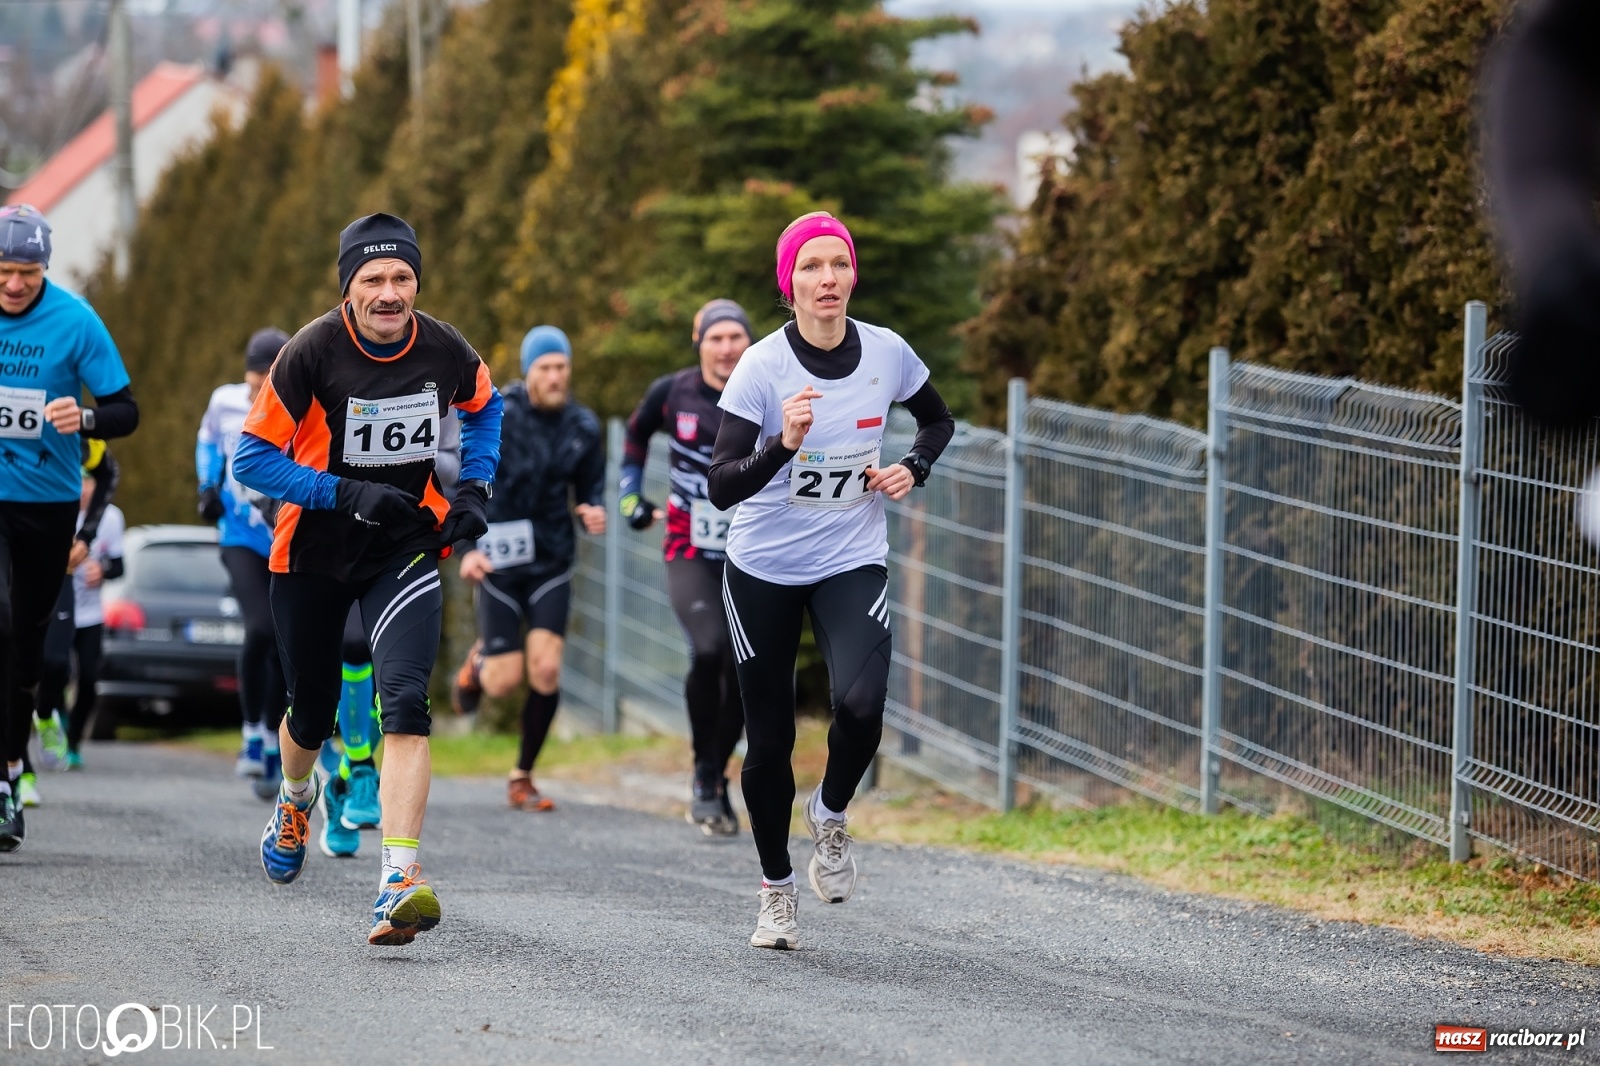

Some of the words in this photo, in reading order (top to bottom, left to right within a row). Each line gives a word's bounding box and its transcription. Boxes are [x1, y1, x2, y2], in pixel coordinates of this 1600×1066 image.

[363, 244, 397, 254] SELECT
[382, 400, 435, 412] www.personalbest.pl
[353, 417, 435, 452] 164
[795, 463, 872, 499] 271
